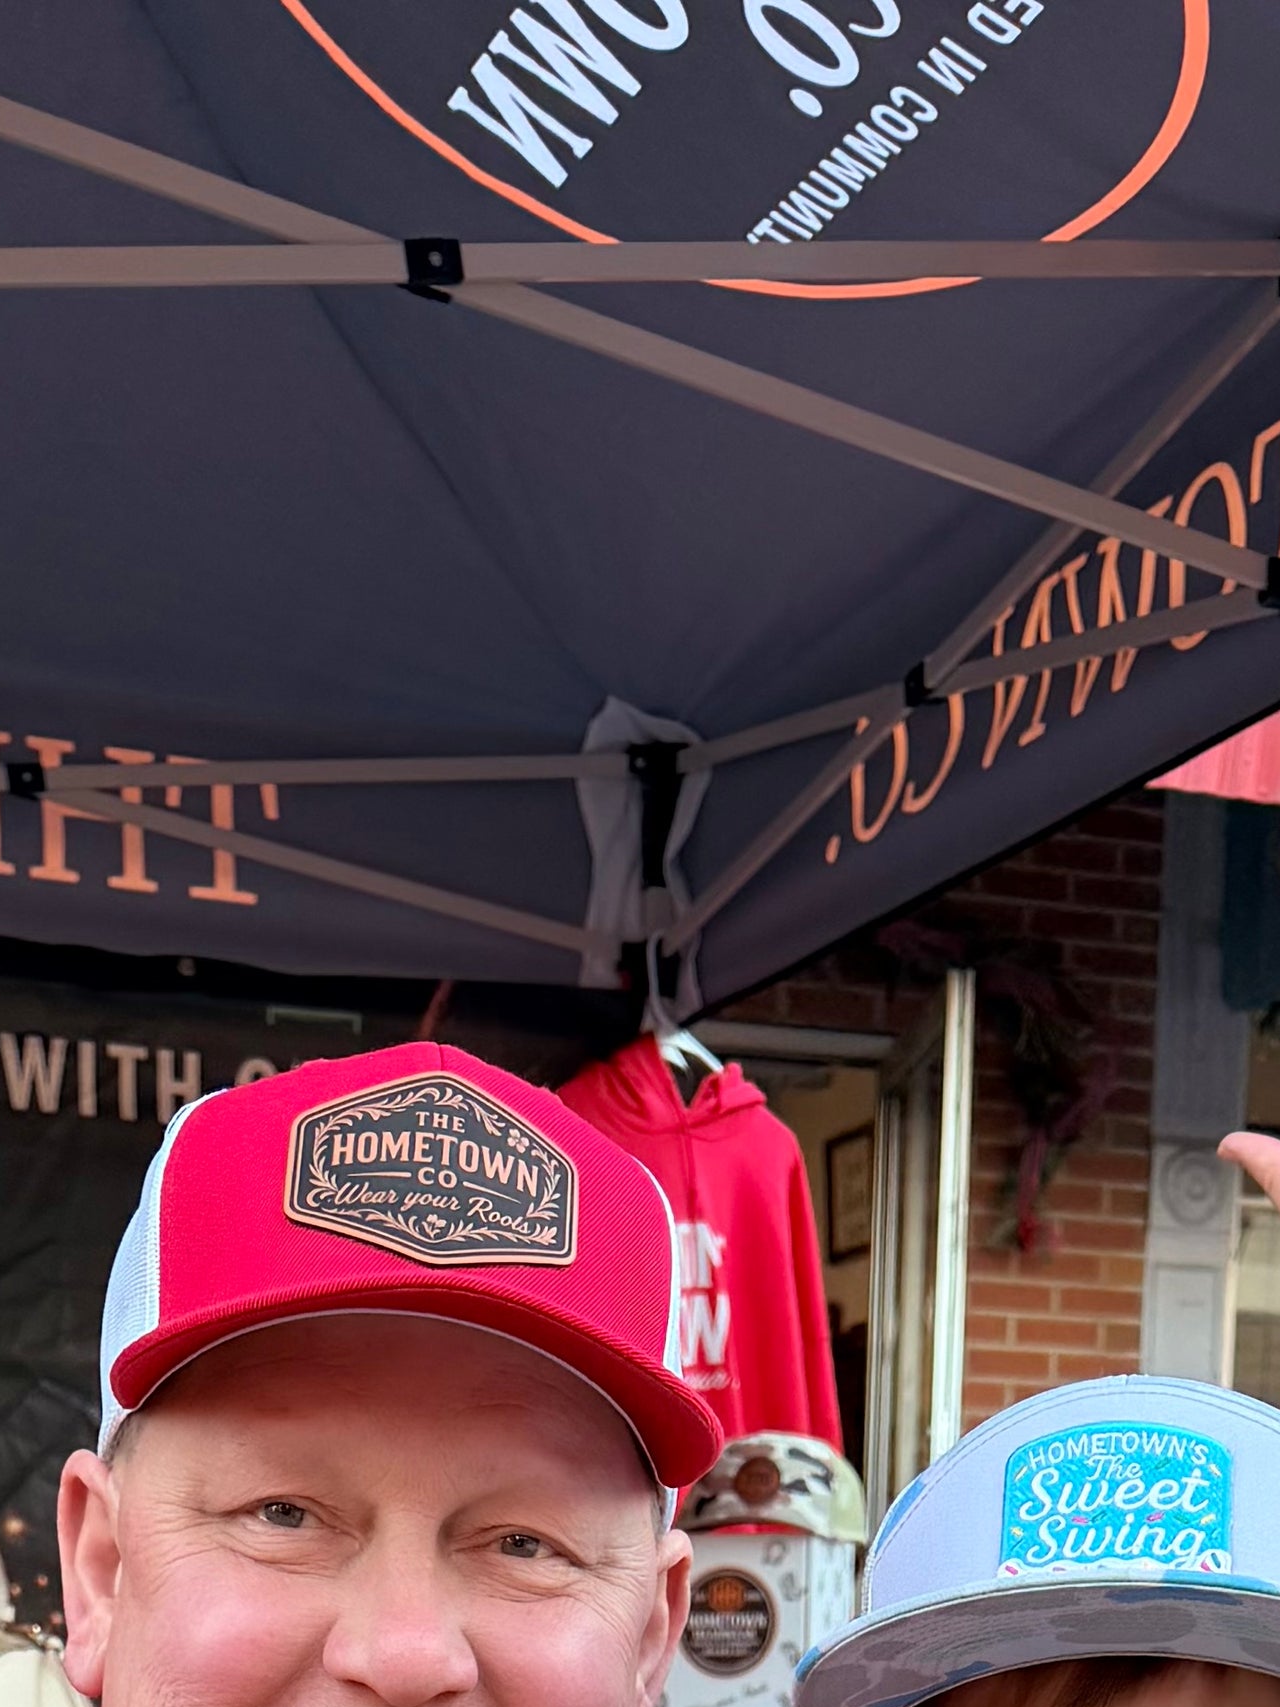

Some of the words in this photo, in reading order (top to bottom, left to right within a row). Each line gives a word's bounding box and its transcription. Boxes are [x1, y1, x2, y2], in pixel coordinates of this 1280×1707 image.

[414, 1110, 466, 1135] THE
[330, 1130, 543, 1198] HOMETOWN
[417, 1168, 459, 1190] CO
[334, 1181, 399, 1206] Wear
[400, 1192, 461, 1212] your
[467, 1195, 534, 1234] Roots
[1026, 1430, 1210, 1471] HOMETOWN'S
[1085, 1454, 1145, 1481] The
[1019, 1467, 1212, 1522] Sweet
[1025, 1512, 1208, 1570] Swing
